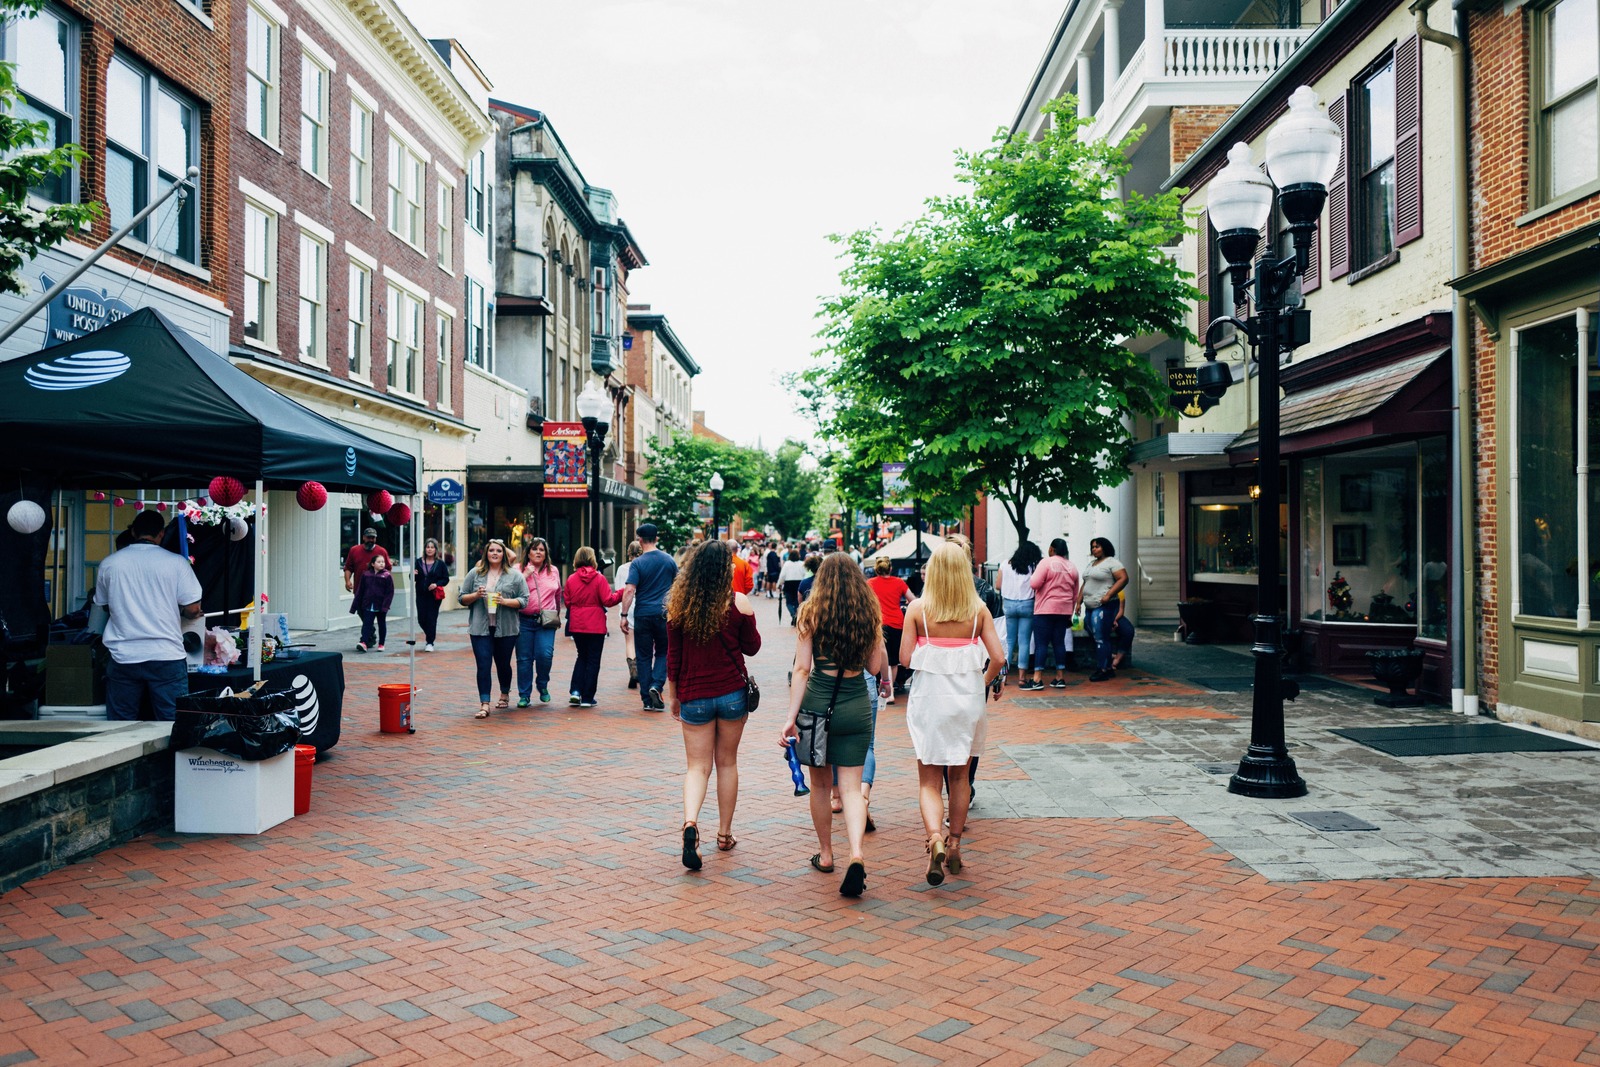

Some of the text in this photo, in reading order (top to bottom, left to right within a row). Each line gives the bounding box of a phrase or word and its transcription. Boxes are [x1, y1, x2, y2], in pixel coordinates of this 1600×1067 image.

[67, 293, 105, 318] UNITED
[73, 314, 100, 332] POST
[188, 757, 235, 767] Winchester
